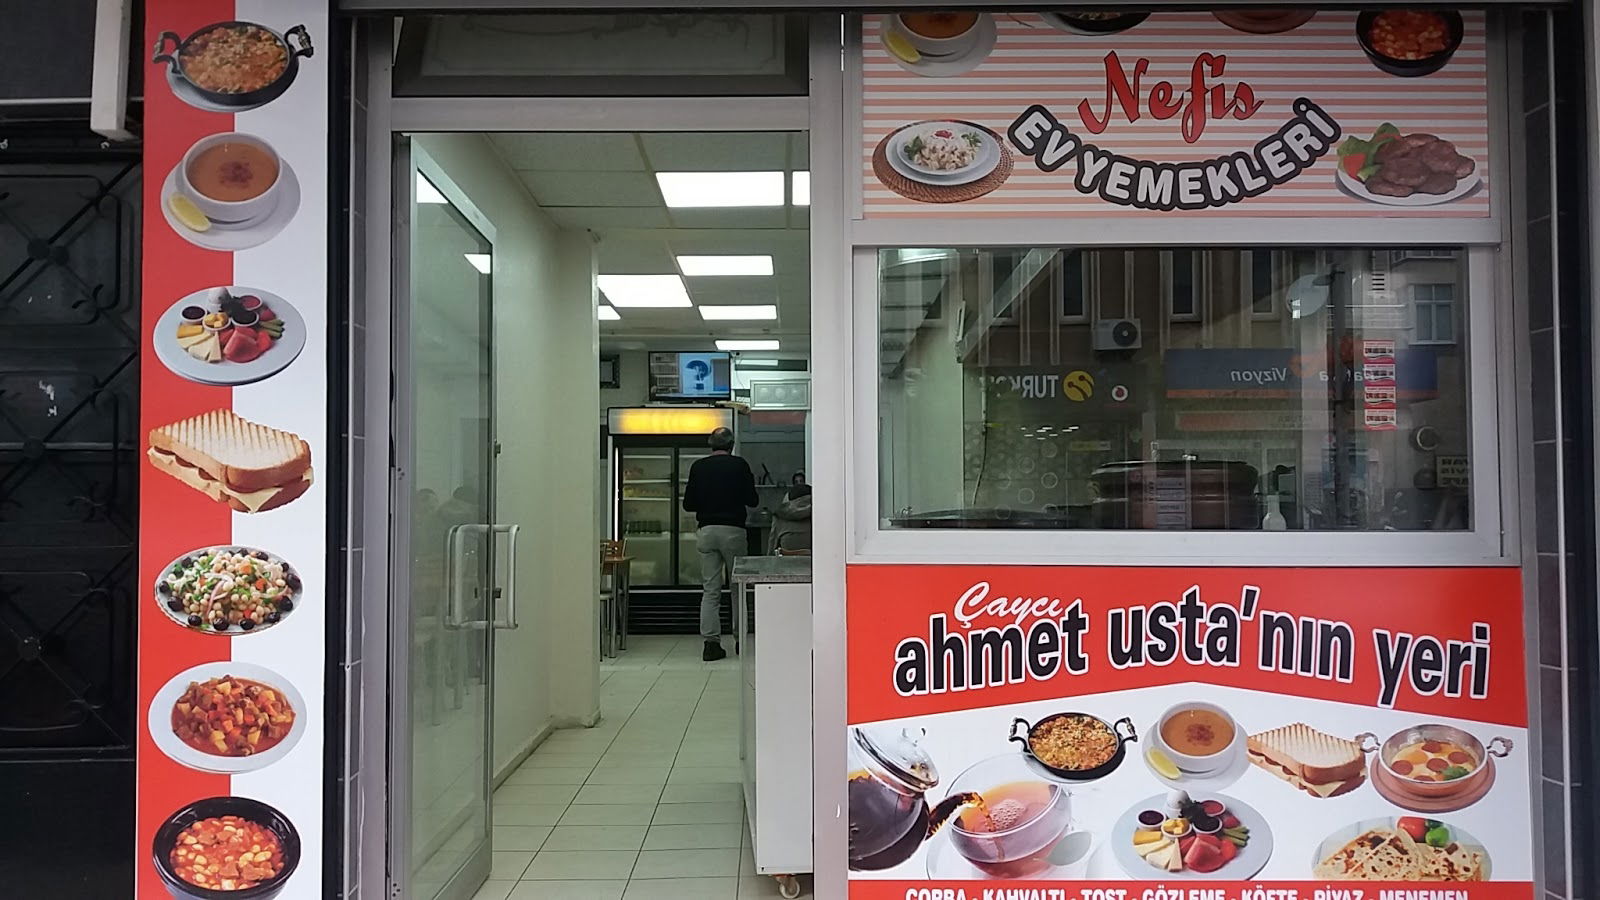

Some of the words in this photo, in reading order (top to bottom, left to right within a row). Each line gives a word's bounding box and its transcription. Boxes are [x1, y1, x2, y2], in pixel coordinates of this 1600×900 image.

[1077, 50, 1264, 143] Nefis
[1010, 107, 1079, 170] EV
[1076, 98, 1340, 210] YEMEKLERİ
[893, 599, 1089, 696] ahmet
[1108, 584, 1354, 683] usta'nın
[1372, 622, 1491, 708] yeri
[954, 581, 1064, 628] Çaycı
